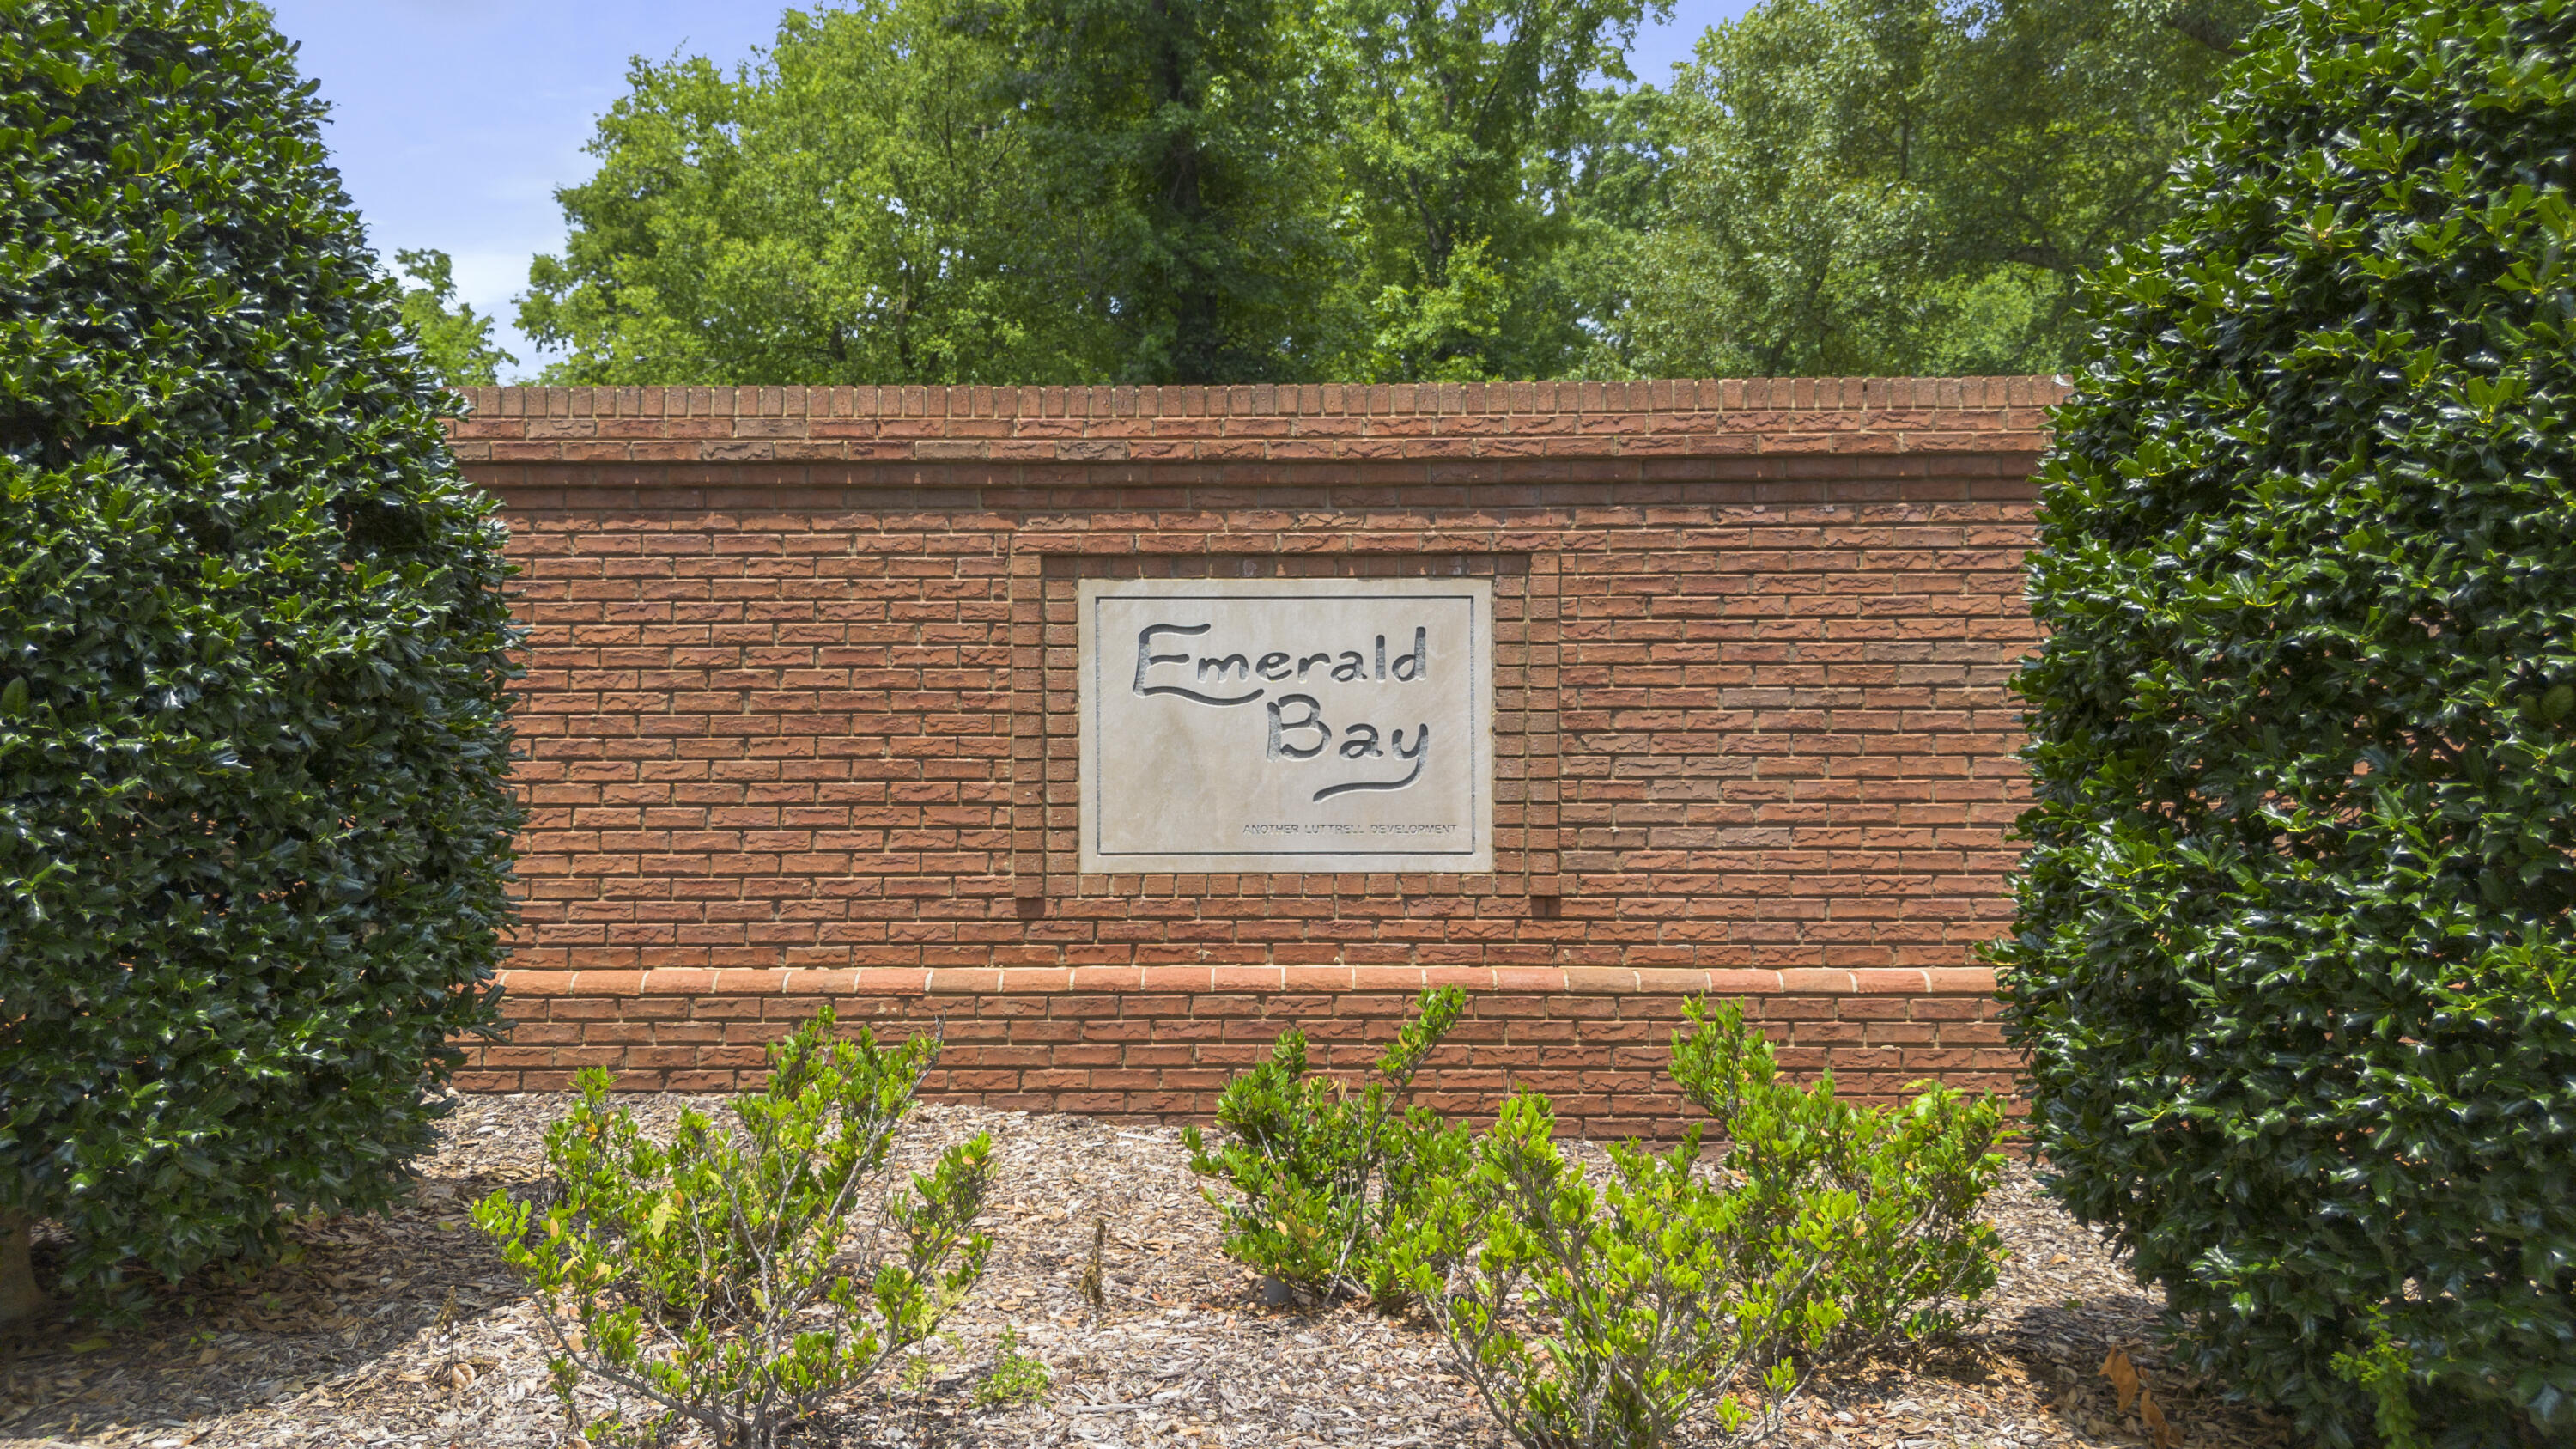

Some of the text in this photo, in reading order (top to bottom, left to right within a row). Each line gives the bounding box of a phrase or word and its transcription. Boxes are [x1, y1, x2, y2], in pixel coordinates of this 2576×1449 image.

[1133, 623, 1427, 707] Emerald
[1267, 693, 1429, 803] Bay
[1242, 824, 1459, 835] ANOTHER LUTTRELL DEVELOPMENT
